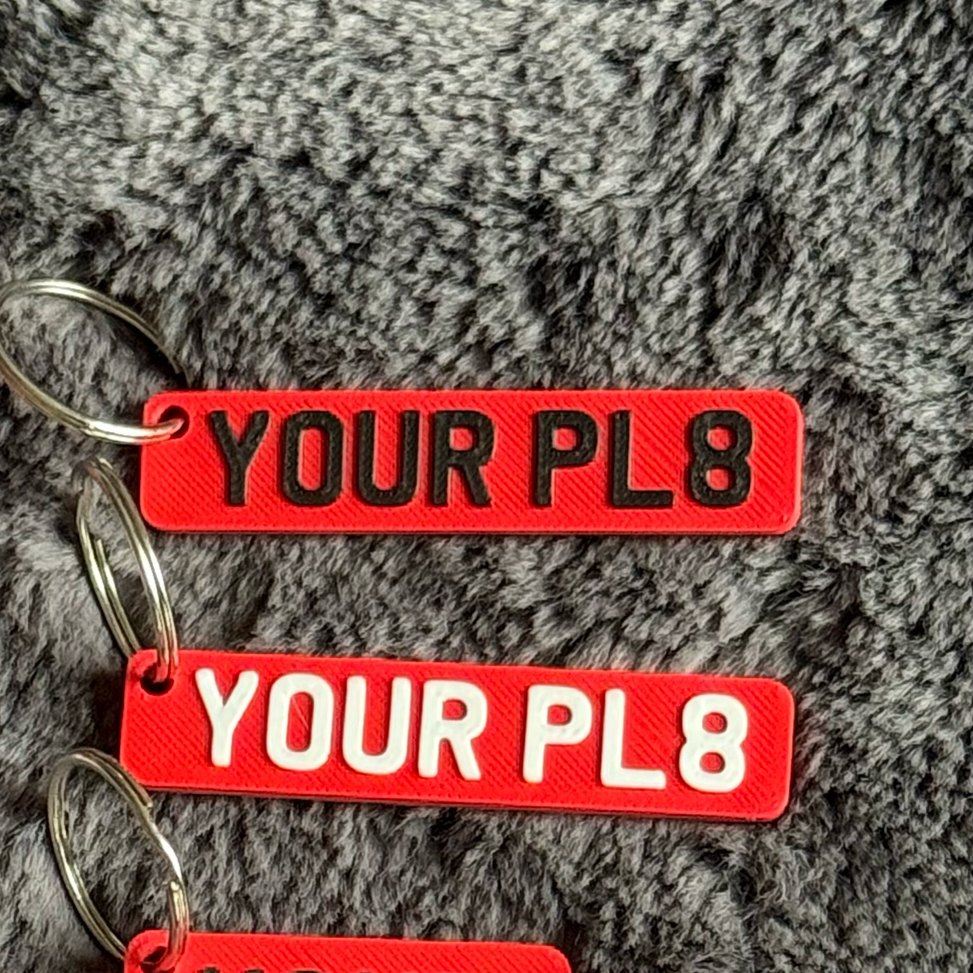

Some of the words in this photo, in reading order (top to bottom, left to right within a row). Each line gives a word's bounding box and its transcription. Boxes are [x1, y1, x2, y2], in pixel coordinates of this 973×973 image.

[210, 409, 495, 506] YOUR
[533, 409, 754, 508] PL8
[195, 668, 489, 780] YOUR
[523, 684, 749, 793] PL8
